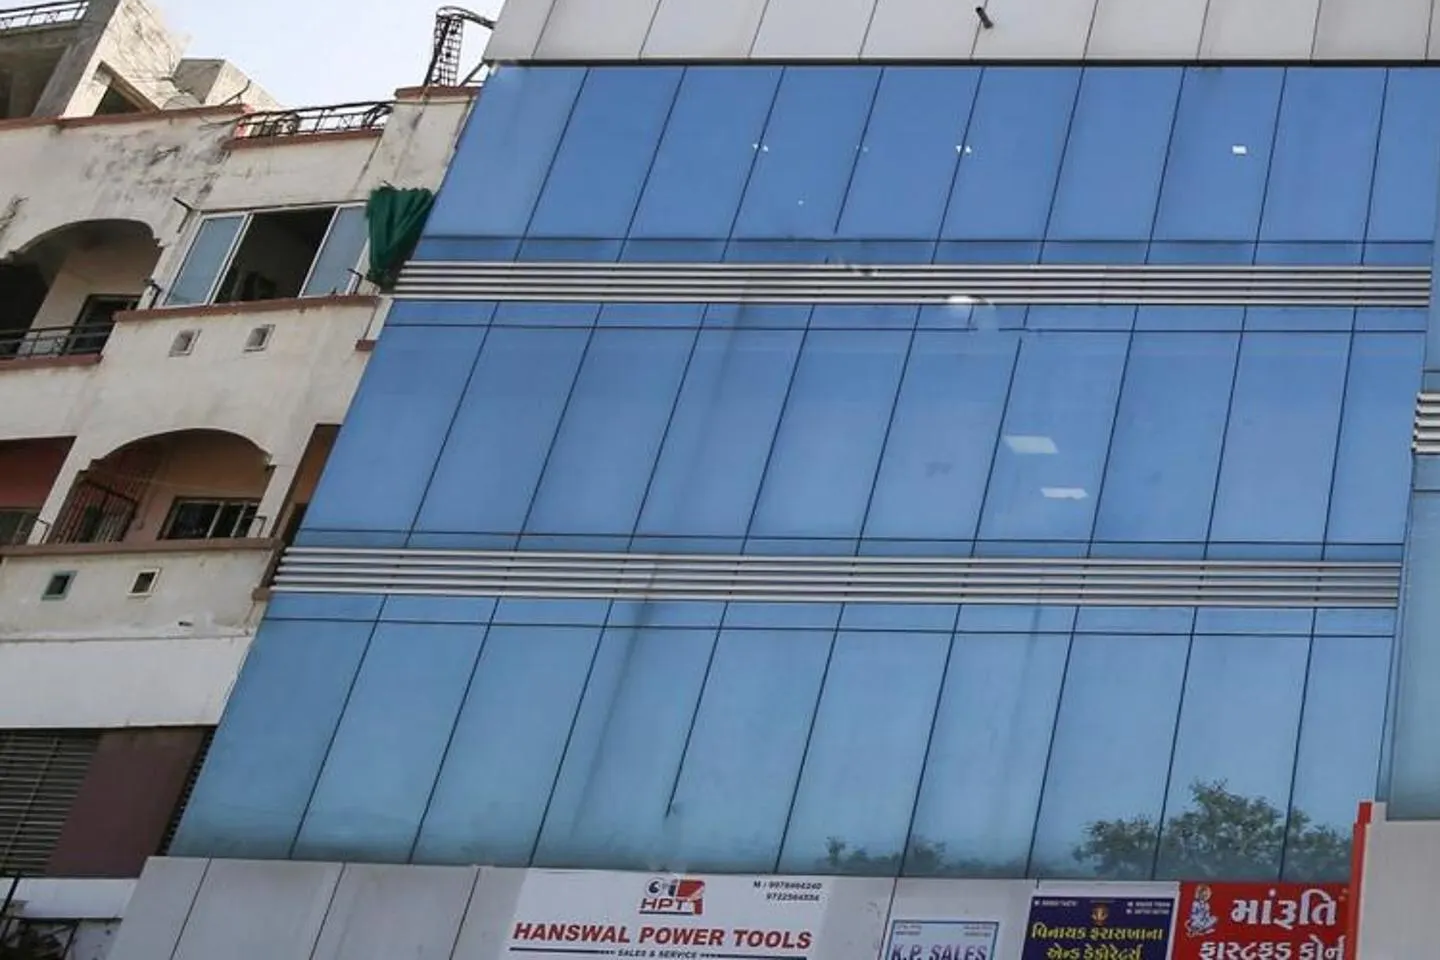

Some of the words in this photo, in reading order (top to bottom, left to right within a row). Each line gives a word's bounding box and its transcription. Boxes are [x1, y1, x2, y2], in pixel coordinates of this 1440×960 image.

[640, 898, 688, 911] HPT
[512, 922, 631, 944] HANSWAL
[639, 926, 724, 946] POWER
[732, 929, 813, 949] TOOLS
[929, 944, 988, 960] SALES
